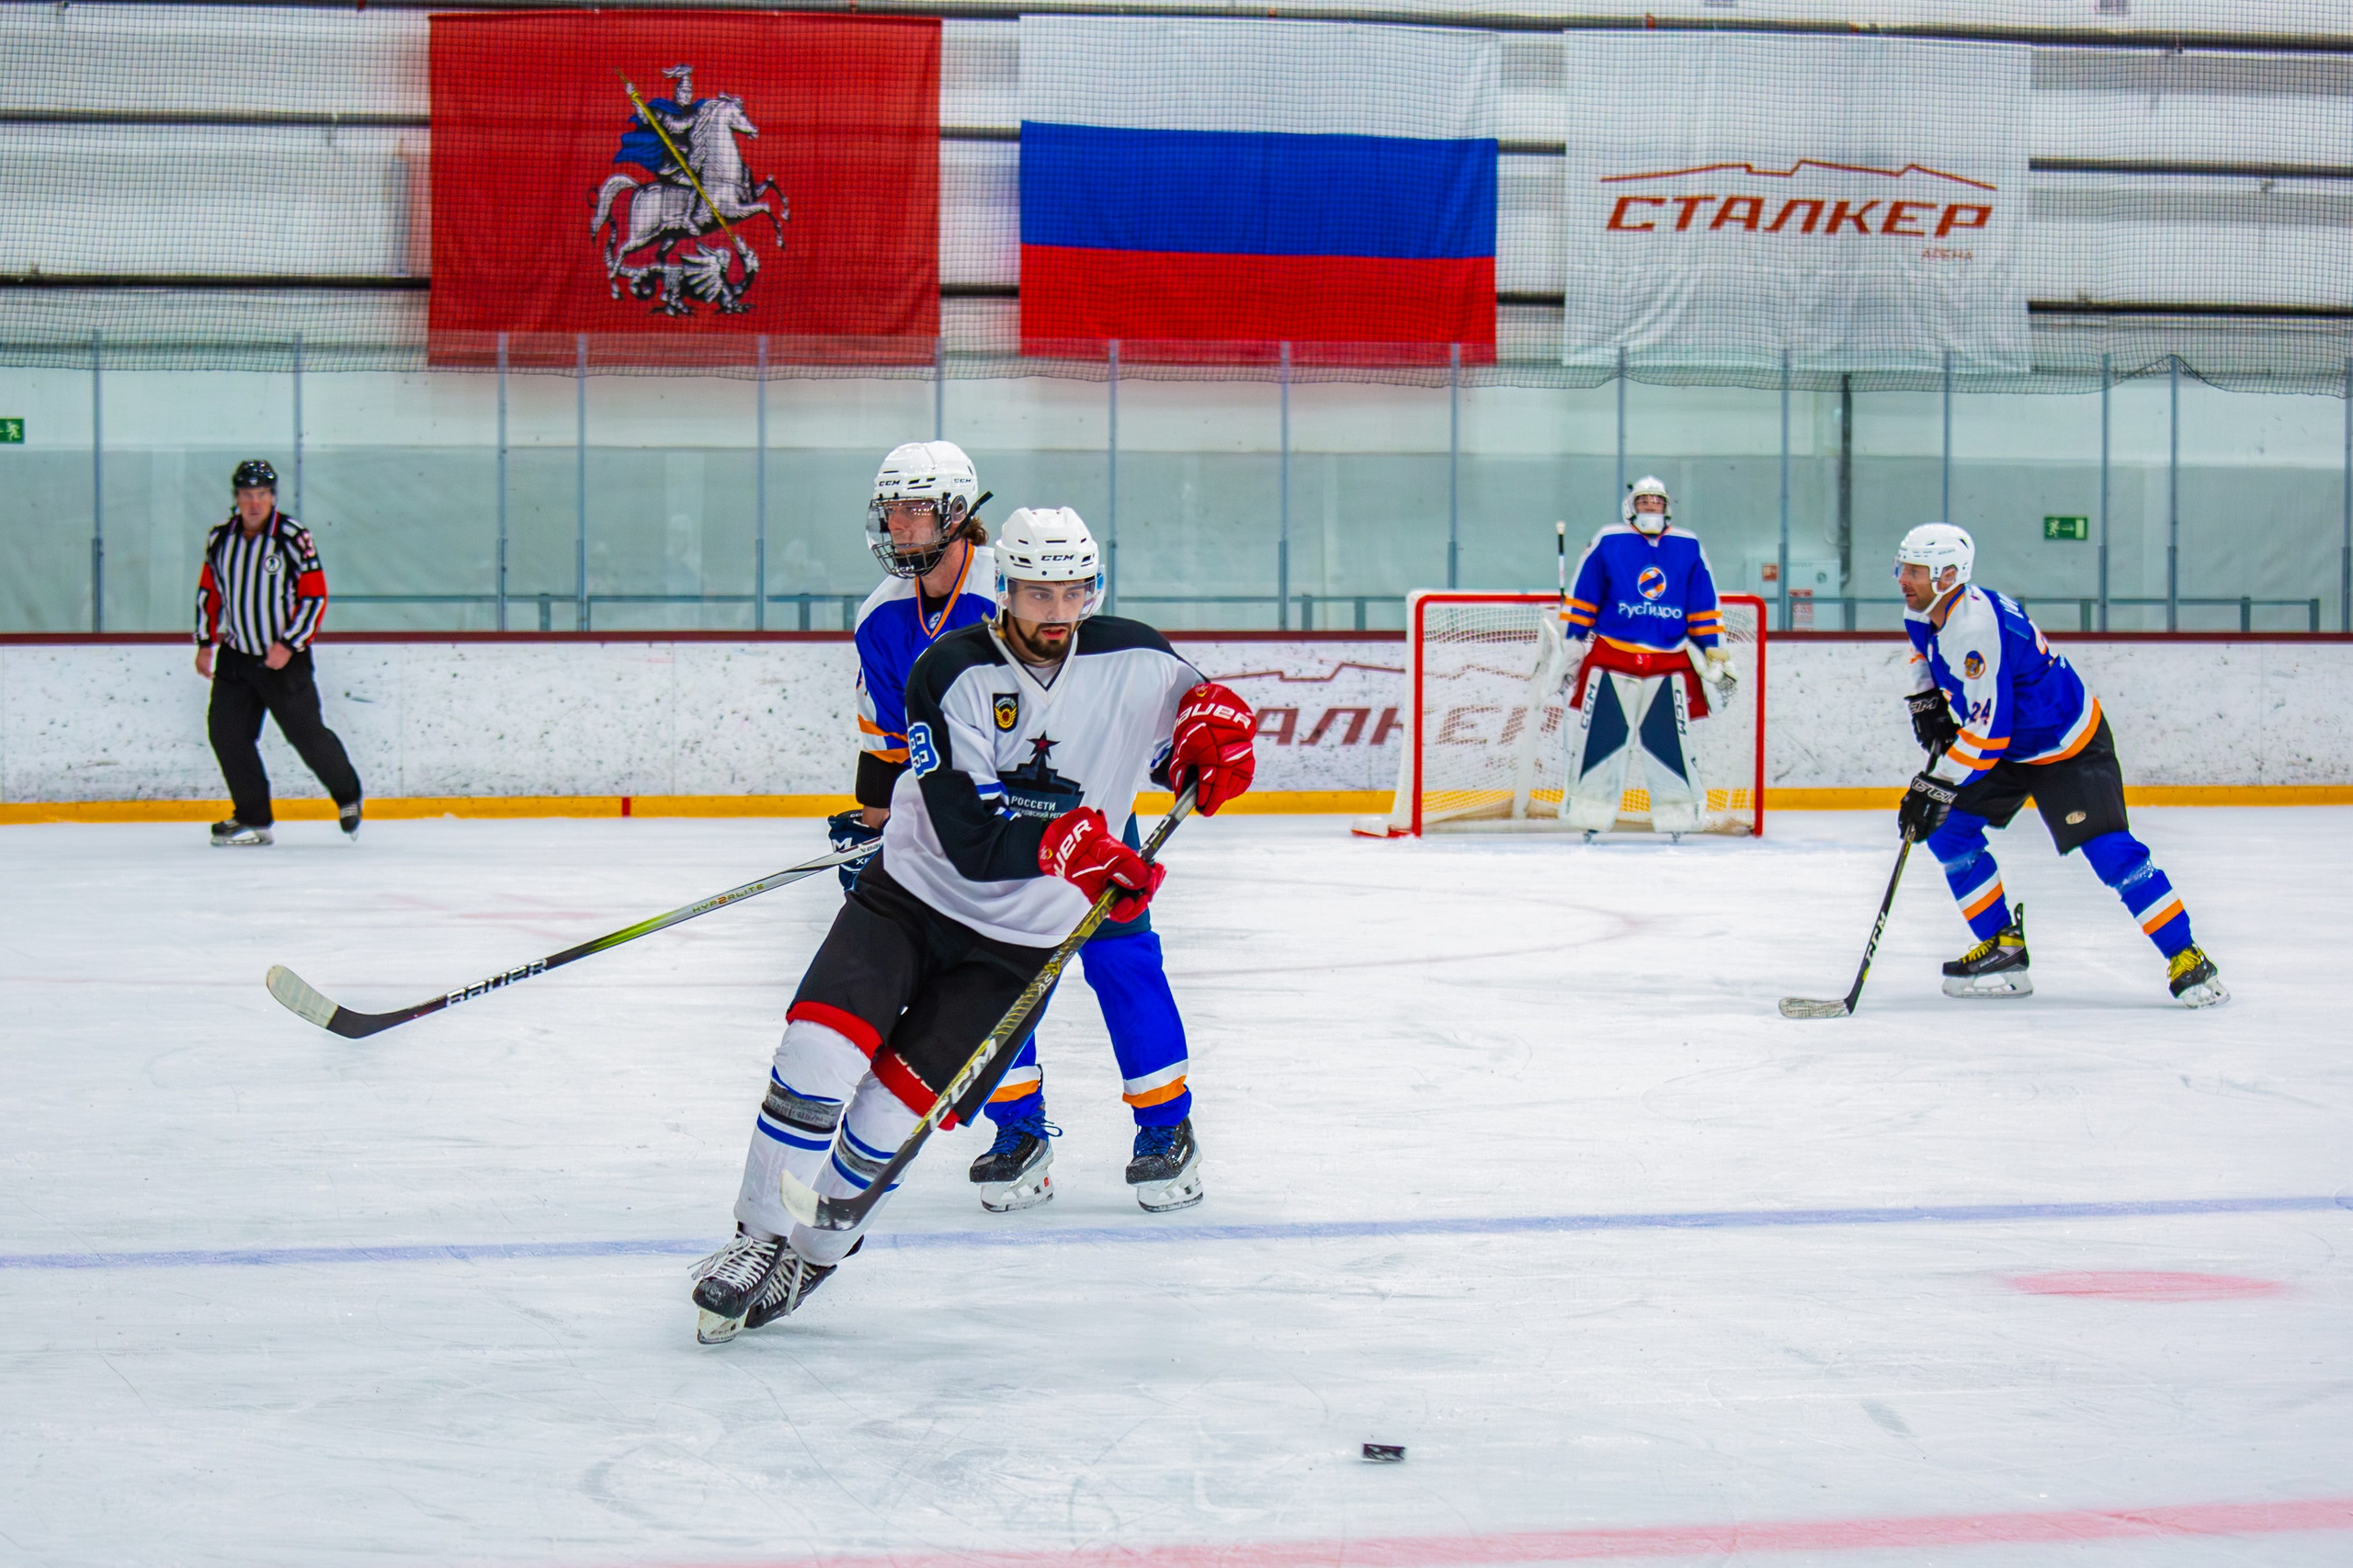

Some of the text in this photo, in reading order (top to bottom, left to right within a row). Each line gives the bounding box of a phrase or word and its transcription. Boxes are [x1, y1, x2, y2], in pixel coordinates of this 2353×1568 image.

[1606, 194, 1993, 238] СТАЛКЕР
[878, 479, 901, 487] CCM
[1040, 554, 1075, 562] CCM
[1172, 702, 1252, 730] AUER
[1580, 683, 1597, 732] CCM
[1673, 688, 1688, 736] CCM
[1969, 699, 1992, 726] 24
[1010, 794, 1057, 812] РОССЕТИ
[928, 1037, 997, 1132] CCM
